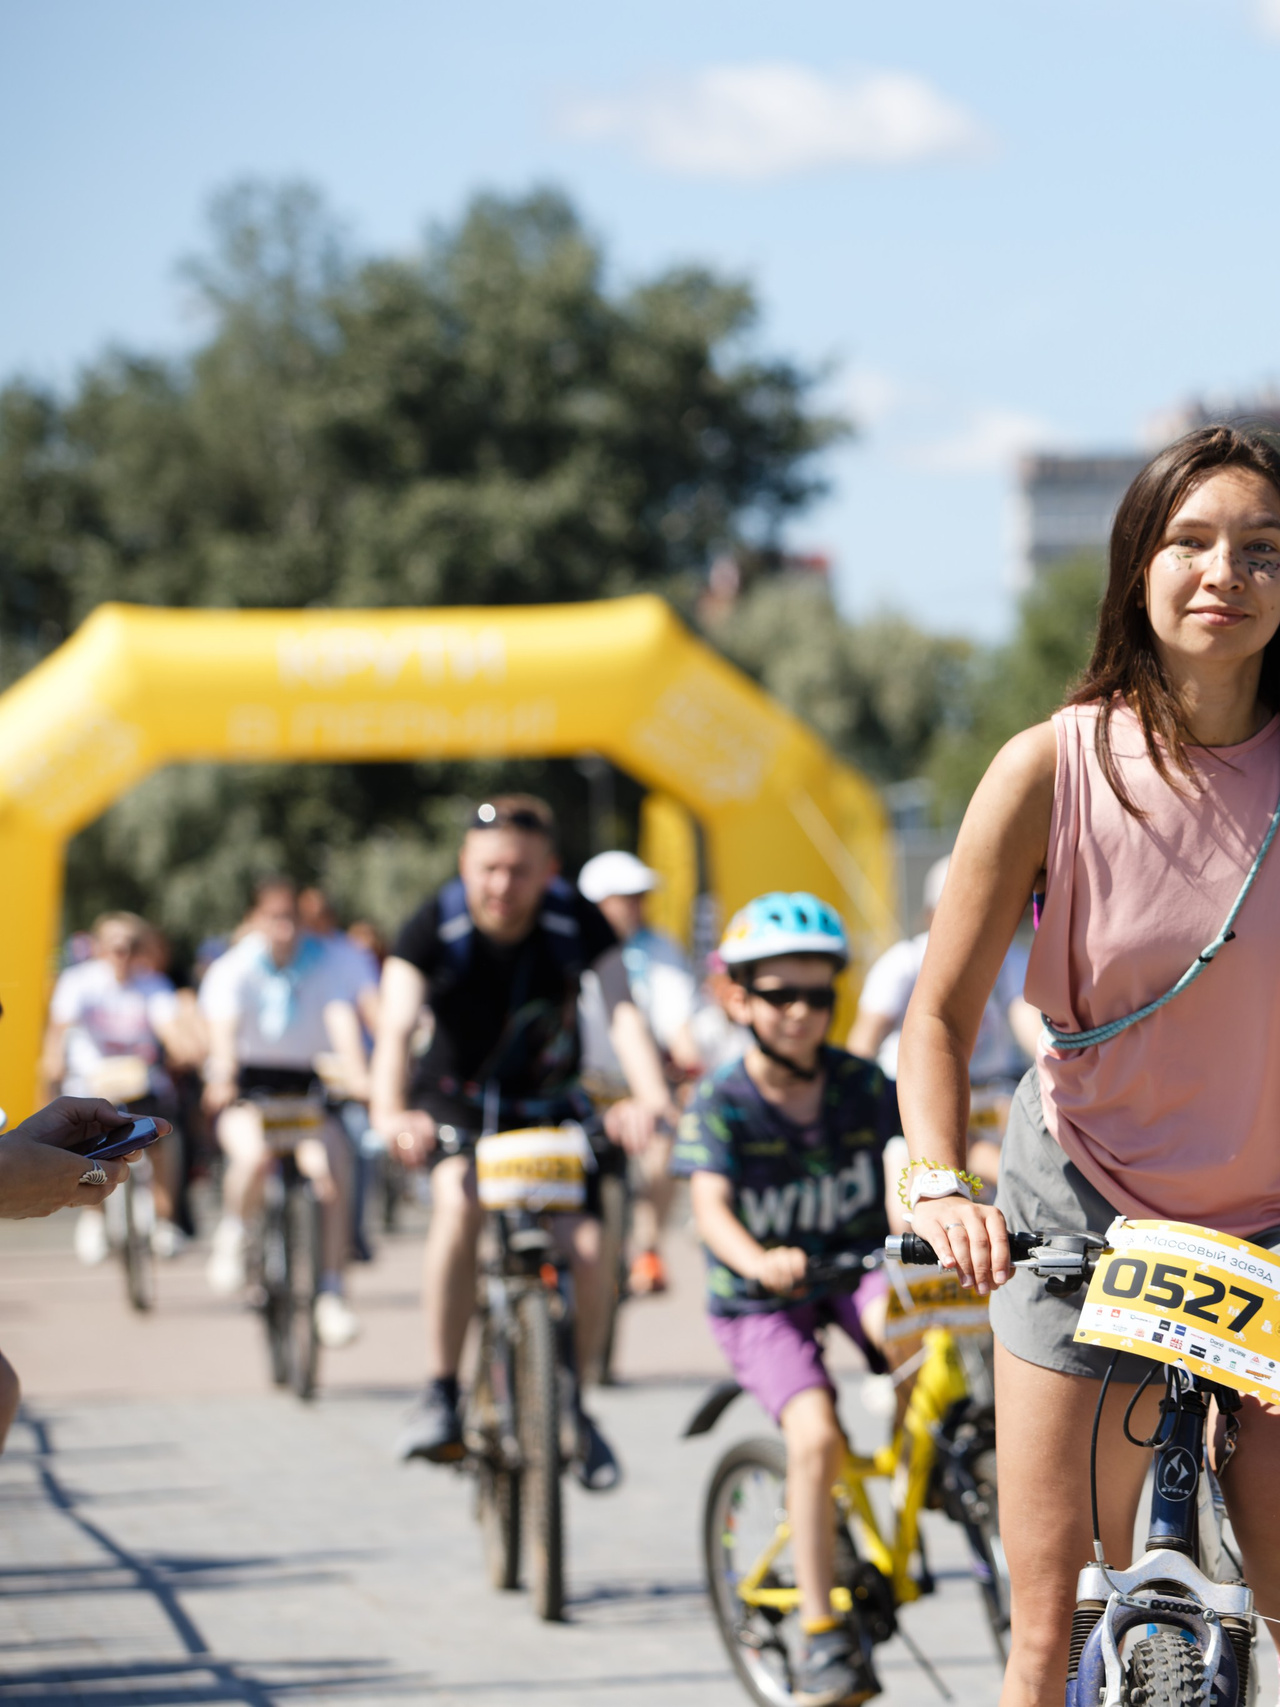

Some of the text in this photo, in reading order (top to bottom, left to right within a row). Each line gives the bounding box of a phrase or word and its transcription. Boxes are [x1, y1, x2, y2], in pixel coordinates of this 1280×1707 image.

[740, 1149, 875, 1237] wild
[1102, 1257, 1264, 1333] 0527
[1144, 1234, 1273, 1284] Массовый заезд
